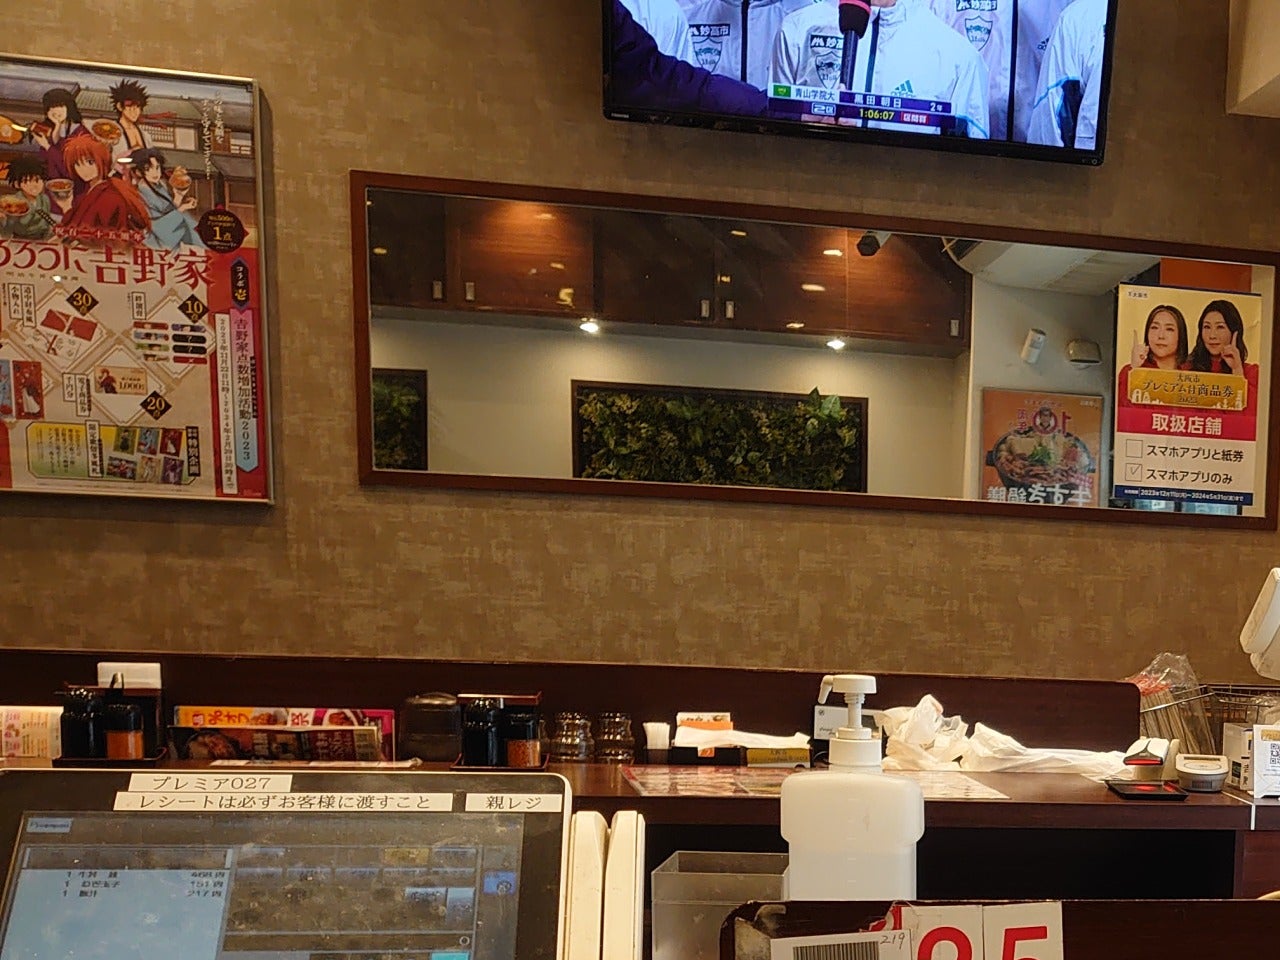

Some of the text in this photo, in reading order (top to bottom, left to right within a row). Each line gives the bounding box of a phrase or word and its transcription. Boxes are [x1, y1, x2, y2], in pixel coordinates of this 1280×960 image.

[859, 109, 895, 120] 1:06:07
[1143, 381, 1234, 398] プレミアム付商品券
[1151, 413, 1223, 435] 取扱店舗
[1146, 445, 1244, 462] スマホアプリと紙券
[1145, 468, 1233, 485] スマホアプリのみ
[153, 775, 272, 791] プレミア027
[140, 793, 543, 811] レシートは必ずお客様に渡すこと 親レジ
